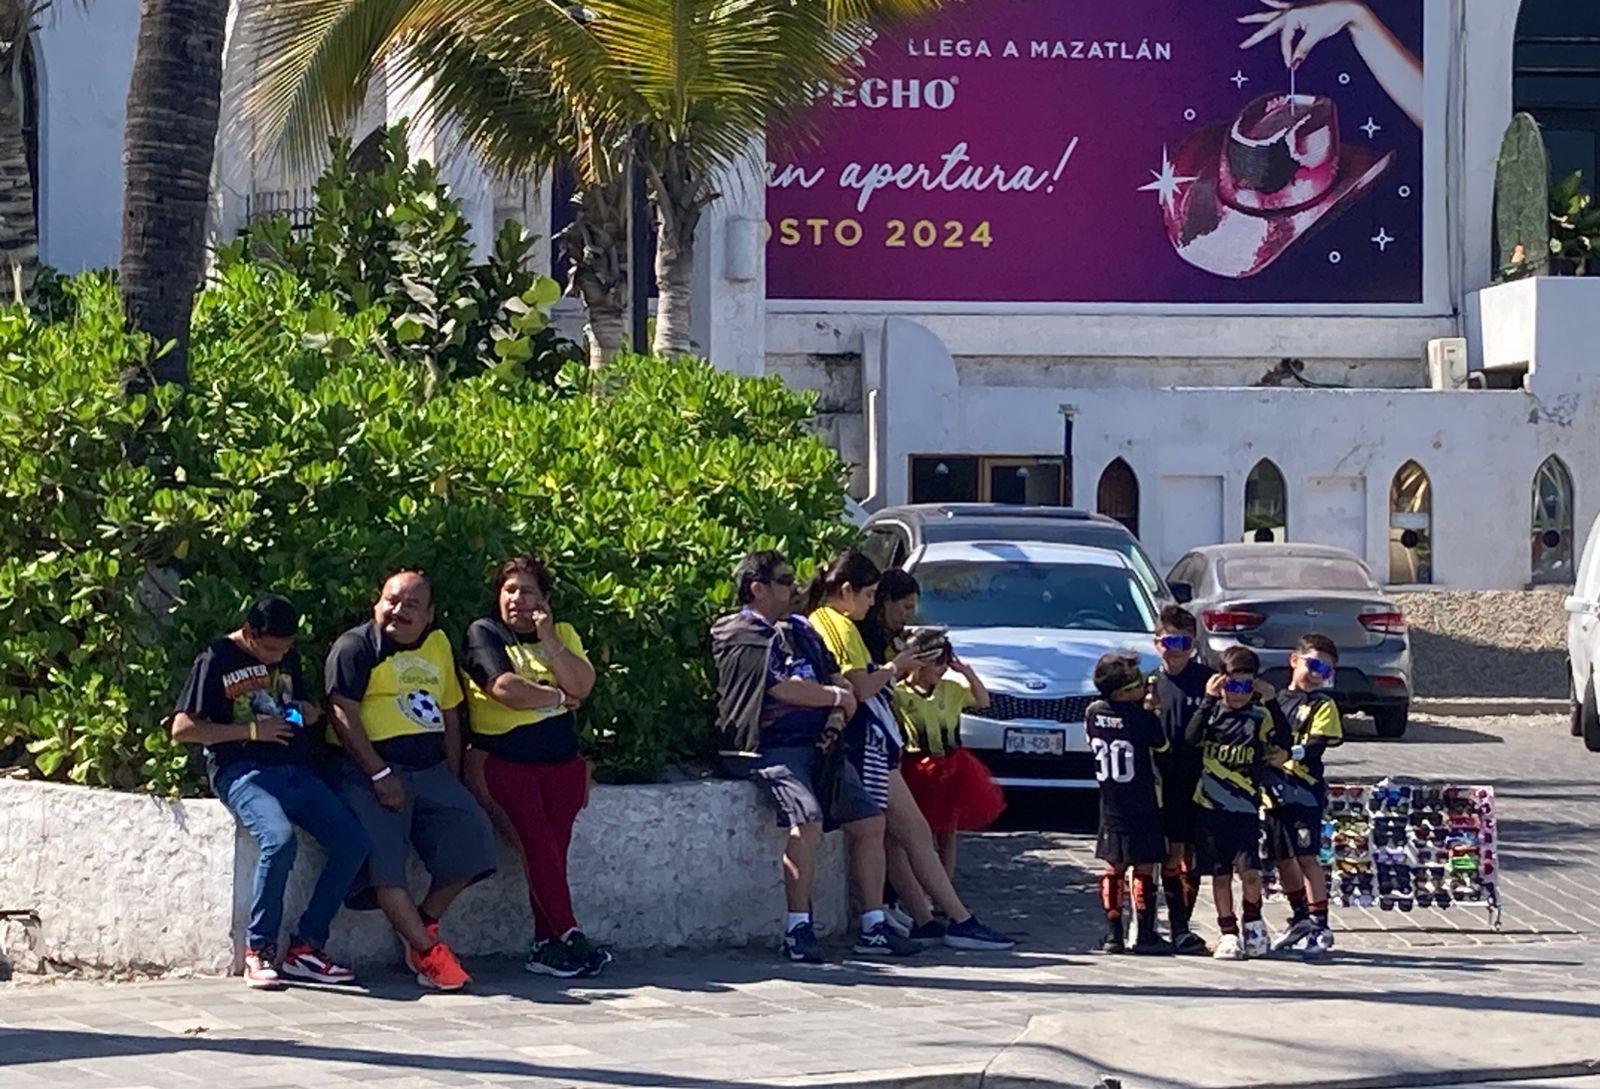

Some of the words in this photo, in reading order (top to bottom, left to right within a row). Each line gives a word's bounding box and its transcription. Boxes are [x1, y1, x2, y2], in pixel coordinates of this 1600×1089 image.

[907, 38, 992, 57] LLEGA
[1002, 40, 1020, 58] A
[1030, 38, 1172, 60] MAZATLÁN
[800, 76, 956, 110] PECHO
[839, 136, 1079, 213] apertura!
[765, 217, 863, 247] STO
[885, 219, 993, 248] 2024
[222, 664, 269, 688] HUNTER
[1090, 737, 1135, 783] 30
